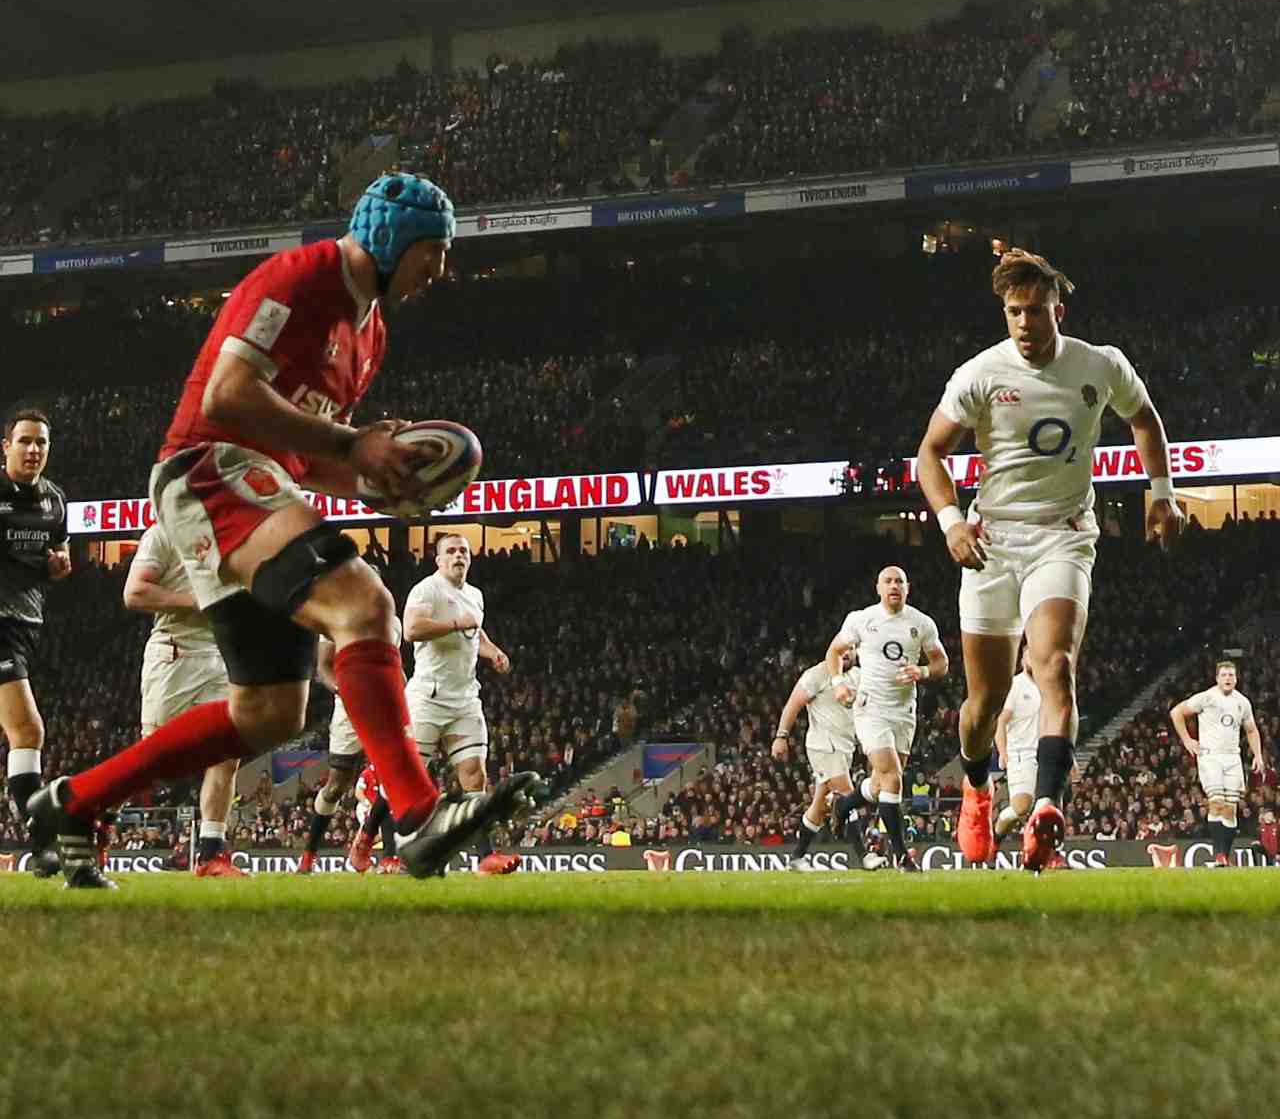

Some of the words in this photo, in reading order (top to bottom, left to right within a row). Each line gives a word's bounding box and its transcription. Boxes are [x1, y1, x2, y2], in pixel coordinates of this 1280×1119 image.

[1138, 157, 1182, 172] England
[1185, 153, 1219, 169] Rugby
[799, 184, 867, 203] TWICKENHAM
[489, 216, 527, 230] England
[209, 237, 270, 253] TWICKENHAM
[1092, 446, 1206, 477] WAES
[463, 474, 629, 513] ENGLAND
[665, 470, 772, 498] WALES
[6, 528, 50, 541] Emirates
[675, 848, 849, 872] GUINNSS
